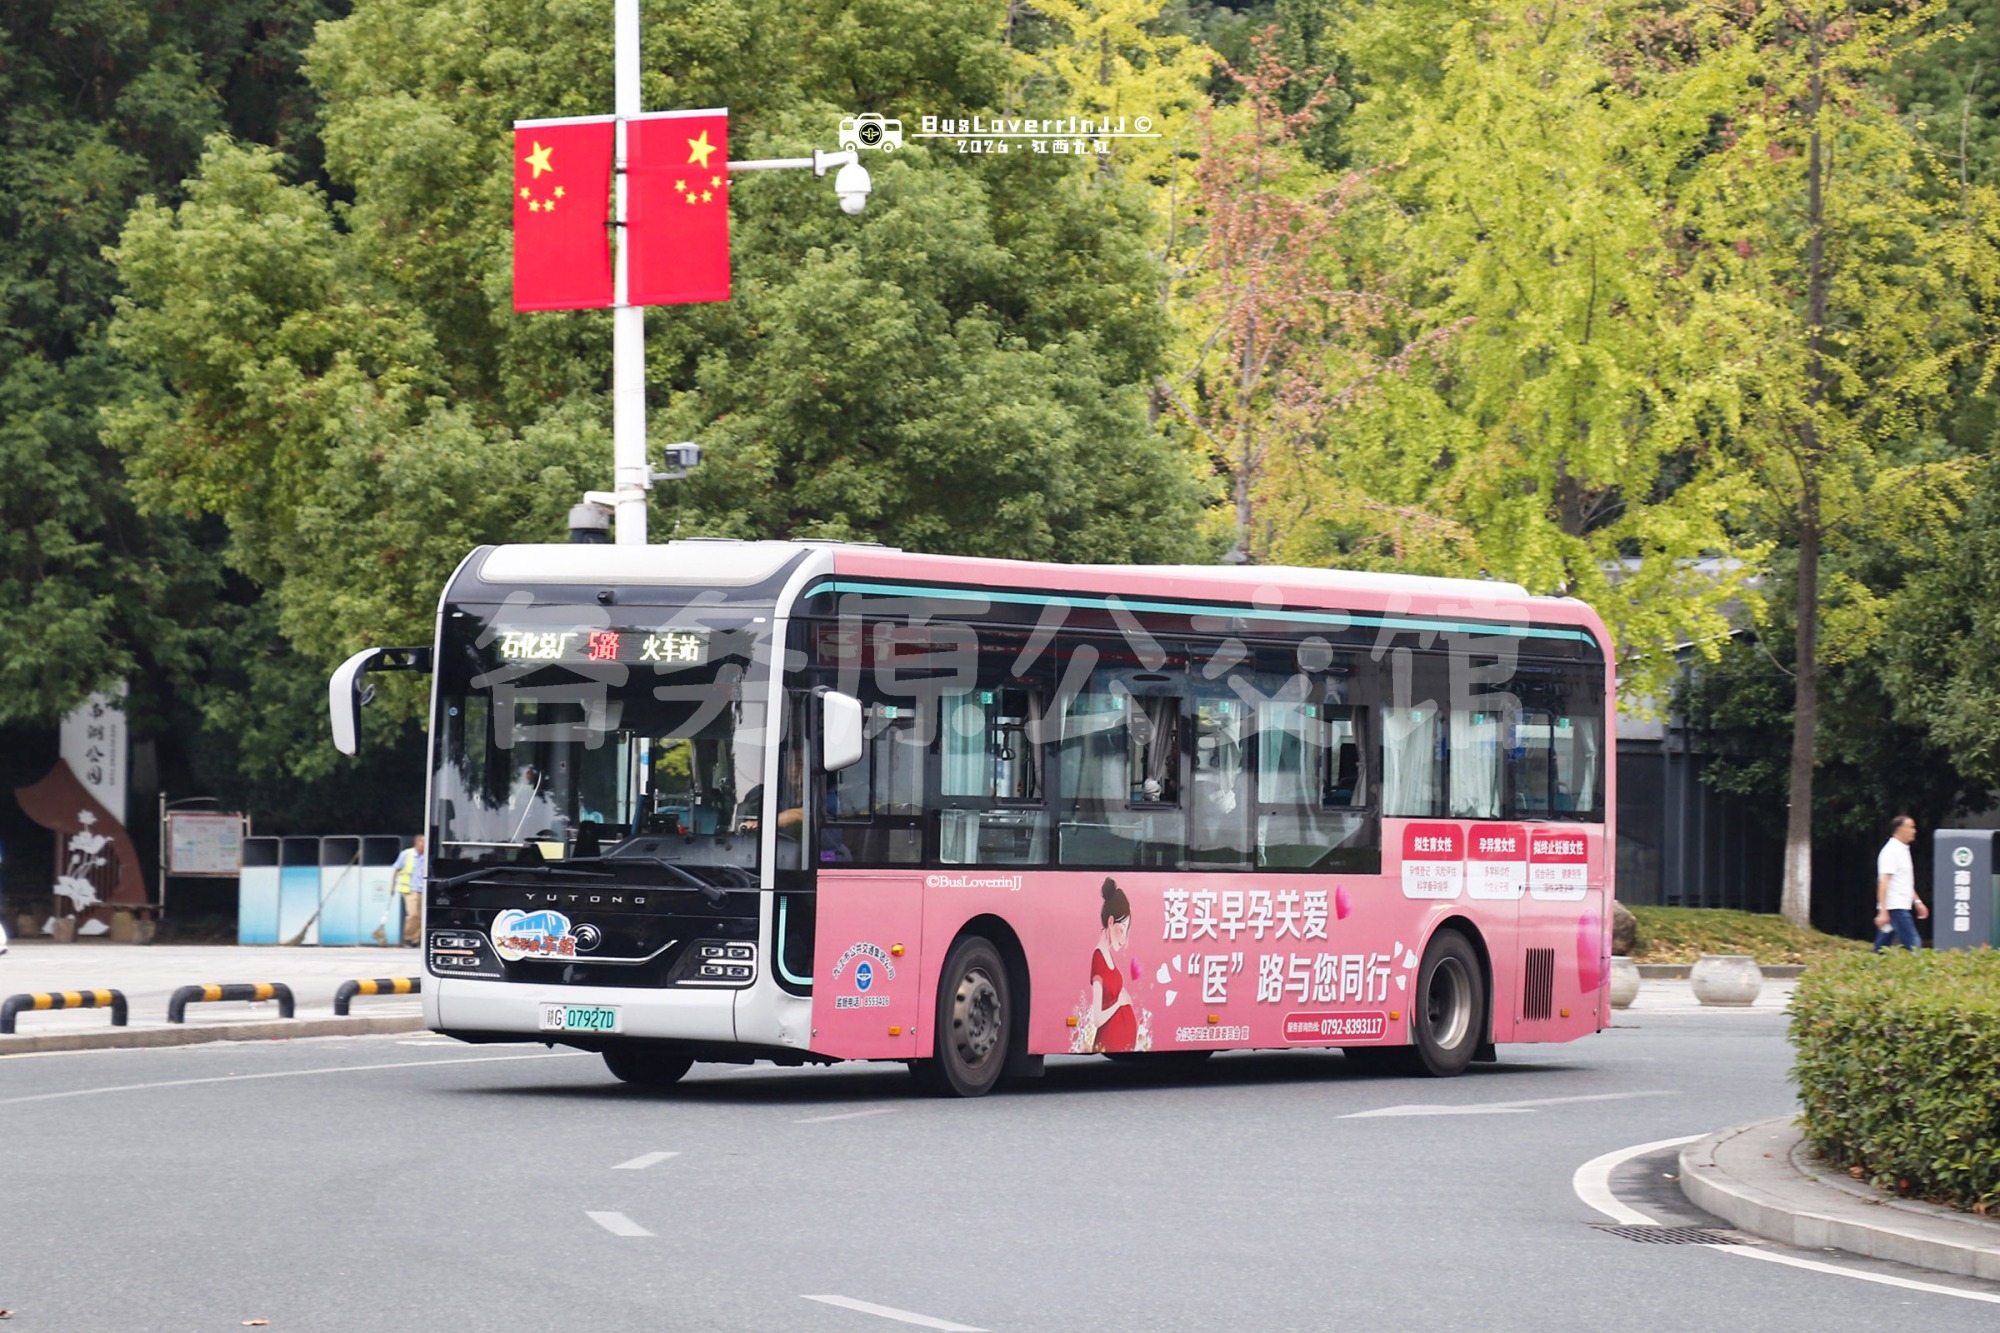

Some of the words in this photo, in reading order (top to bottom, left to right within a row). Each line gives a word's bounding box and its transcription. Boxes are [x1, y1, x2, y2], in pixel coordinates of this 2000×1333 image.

[500, 631, 578, 660] 石化总厂
[588, 630, 620, 662] 5路
[640, 632, 701, 662] 火车站
[526, 893, 646, 904] YUTONG
[1162, 888, 1330, 941] 落实早孕关爱
